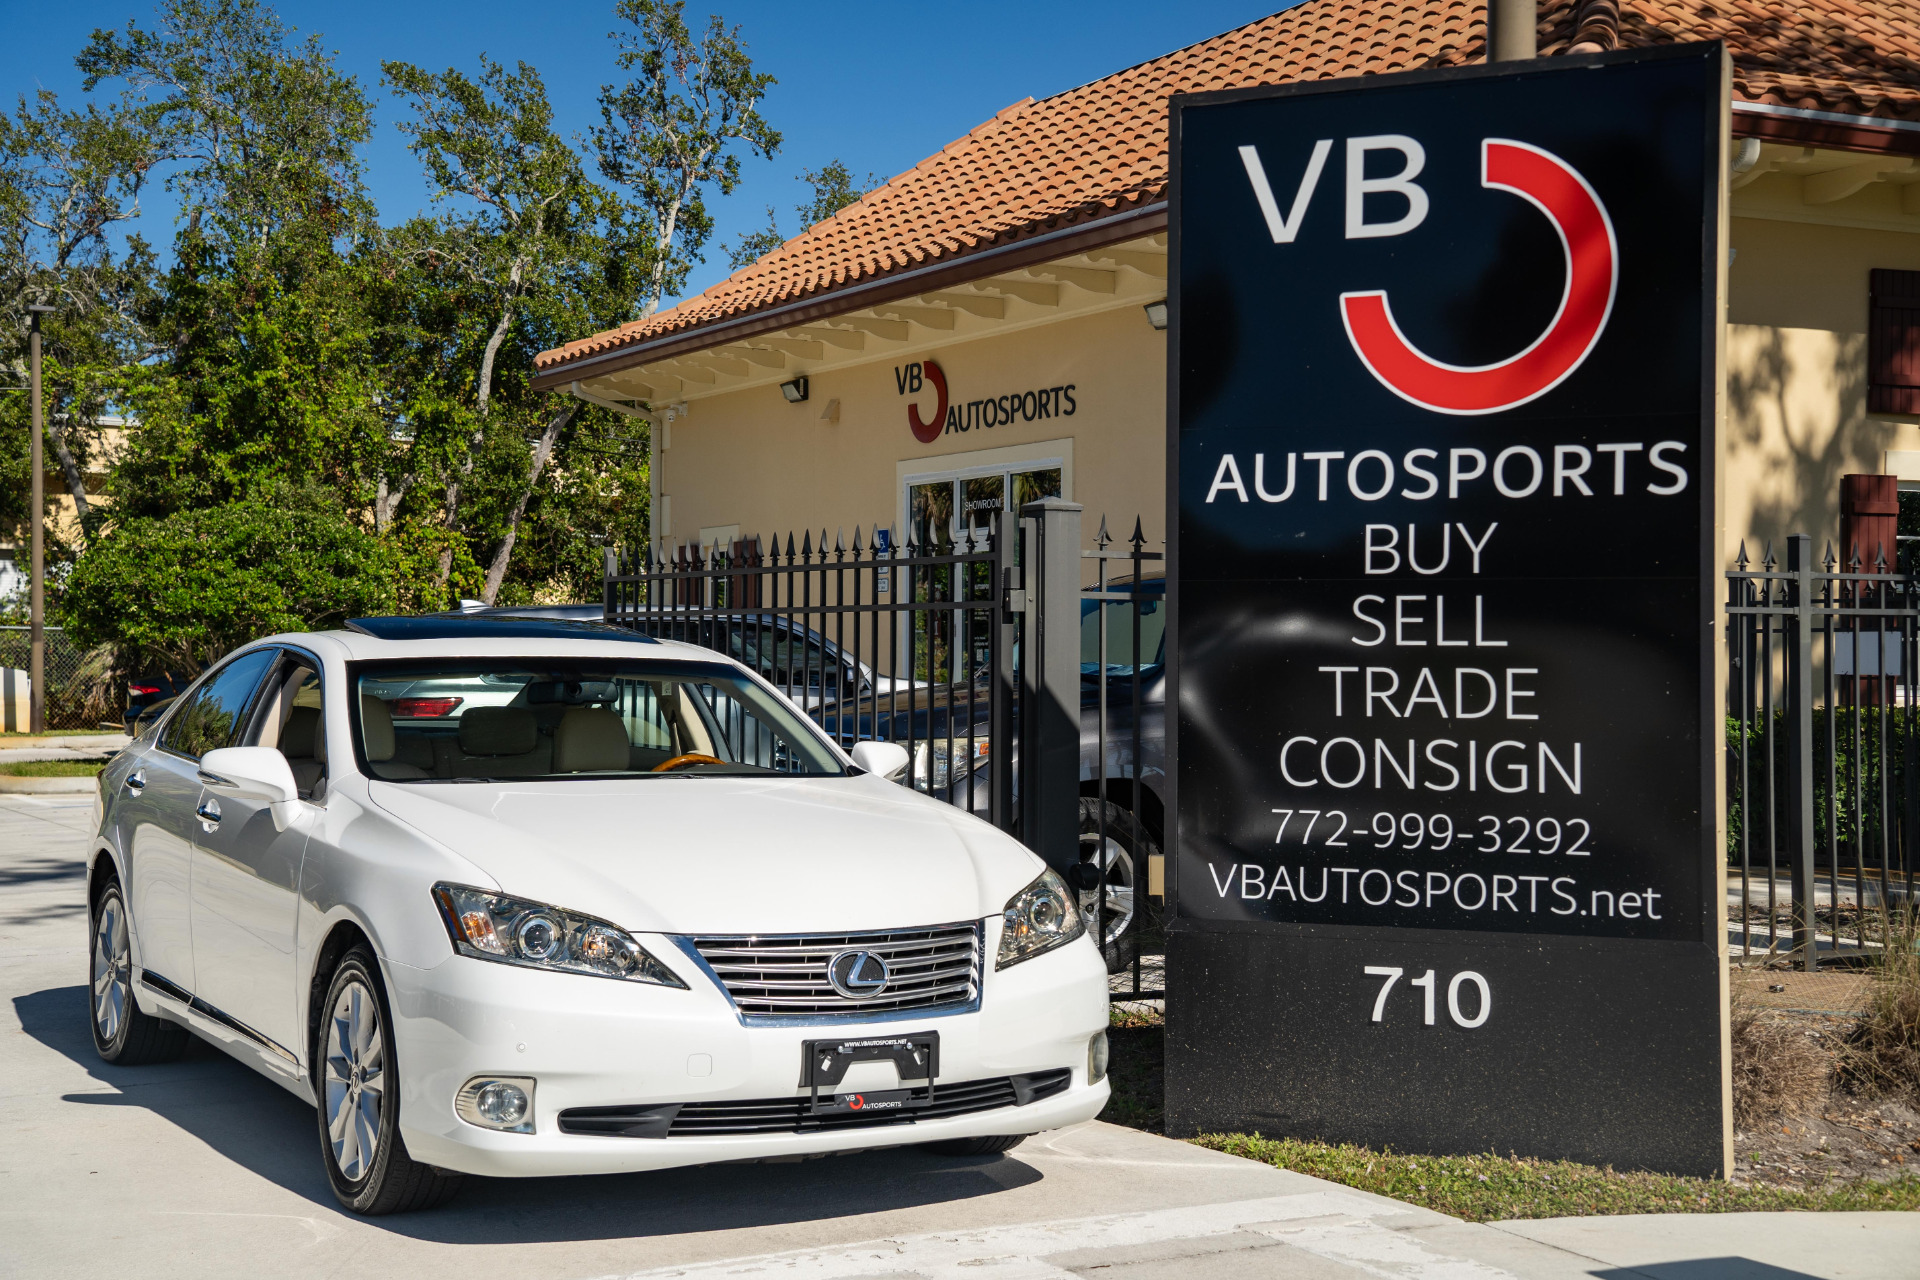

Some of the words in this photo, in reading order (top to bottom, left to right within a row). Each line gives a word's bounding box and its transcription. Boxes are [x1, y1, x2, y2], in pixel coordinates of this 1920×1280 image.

[1238, 134, 1429, 244] VB
[894, 362, 923, 396] VB
[945, 384, 1077, 435] AUTOSPORTS
[1205, 441, 1689, 503] AUTOSPORTS
[964, 498, 1002, 511] SHOWROOM
[1364, 522, 1499, 575] BUY
[1351, 594, 1508, 647] SELL
[1318, 666, 1540, 720] TRADE
[1280, 736, 1582, 795] CONSIGN
[1271, 808, 1592, 857] 772-999-3292
[1208, 862, 1662, 920] VBAUTOSPORTS.net
[1364, 965, 1492, 1029] 710
[844, 1039, 907, 1047] WWW.VBAUTOSPORTS.NET
[845, 1094, 856, 1102] VB
[862, 1101, 902, 1109] AUTOSPORTS
